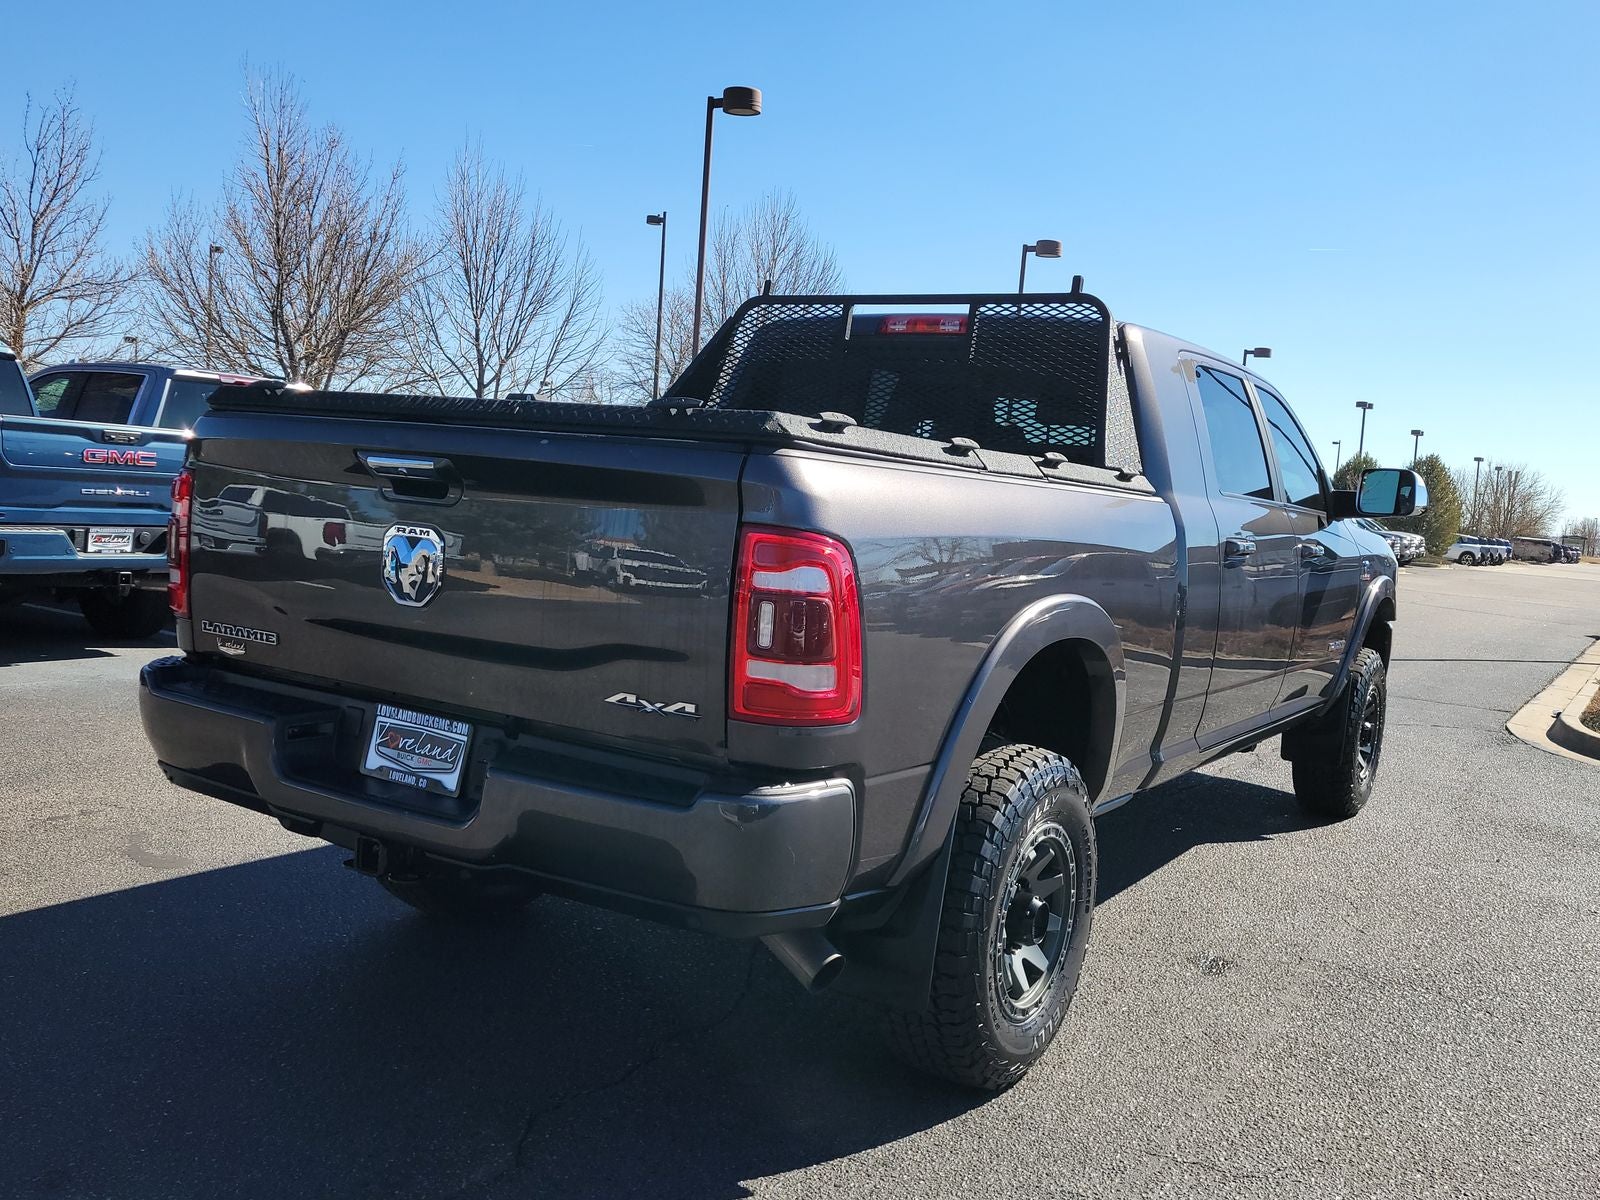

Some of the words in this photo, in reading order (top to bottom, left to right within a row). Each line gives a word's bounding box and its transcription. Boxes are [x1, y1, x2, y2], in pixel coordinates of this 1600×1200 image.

[83, 448, 157, 467] GMC
[81, 488, 150, 497] DENALI
[395, 526, 430, 537] RAM
[201, 620, 277, 646] LARAMIE
[377, 703, 469, 736] LOVELANDBUICKGMC.COM
